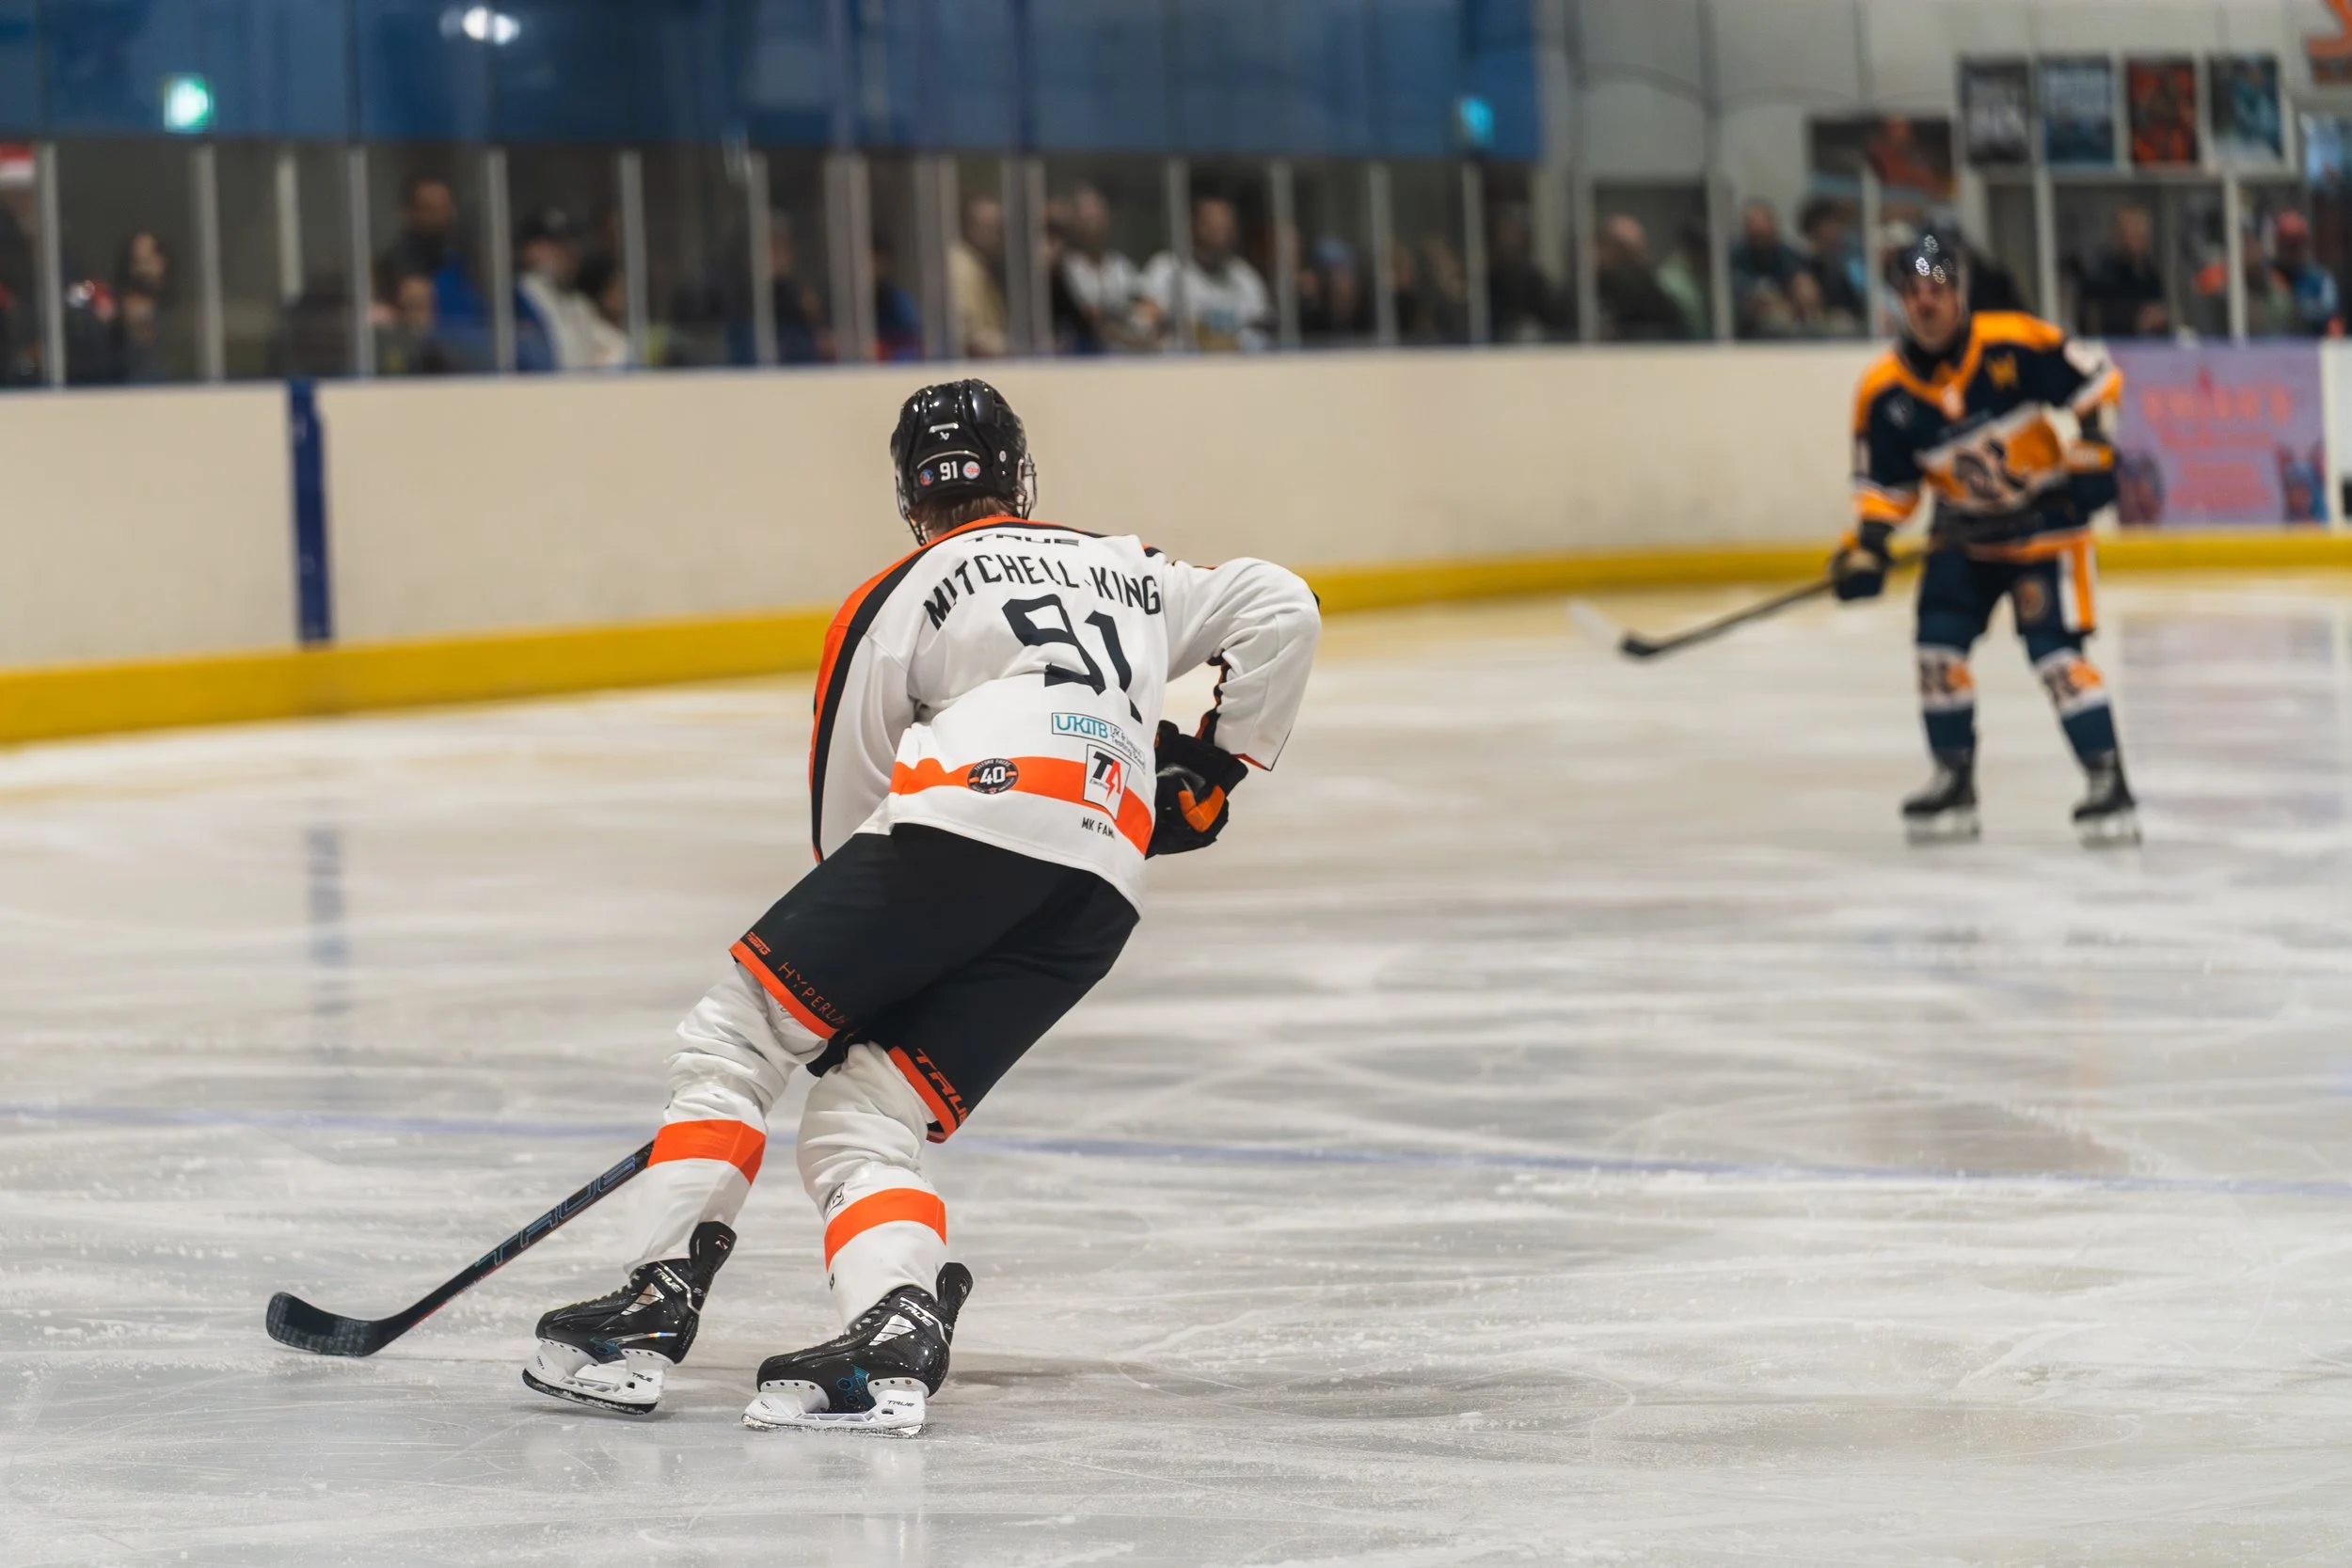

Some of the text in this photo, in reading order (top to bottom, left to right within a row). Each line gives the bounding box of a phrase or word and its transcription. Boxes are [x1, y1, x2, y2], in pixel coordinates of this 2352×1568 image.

[940, 461, 958, 481] 91
[1001, 594, 1143, 725] 91
[979, 767, 1006, 784] 40
[654, 1267, 683, 1293] TRUE
[899, 1302, 934, 1327] TRUE
[632, 1372, 653, 1383] TRUE
